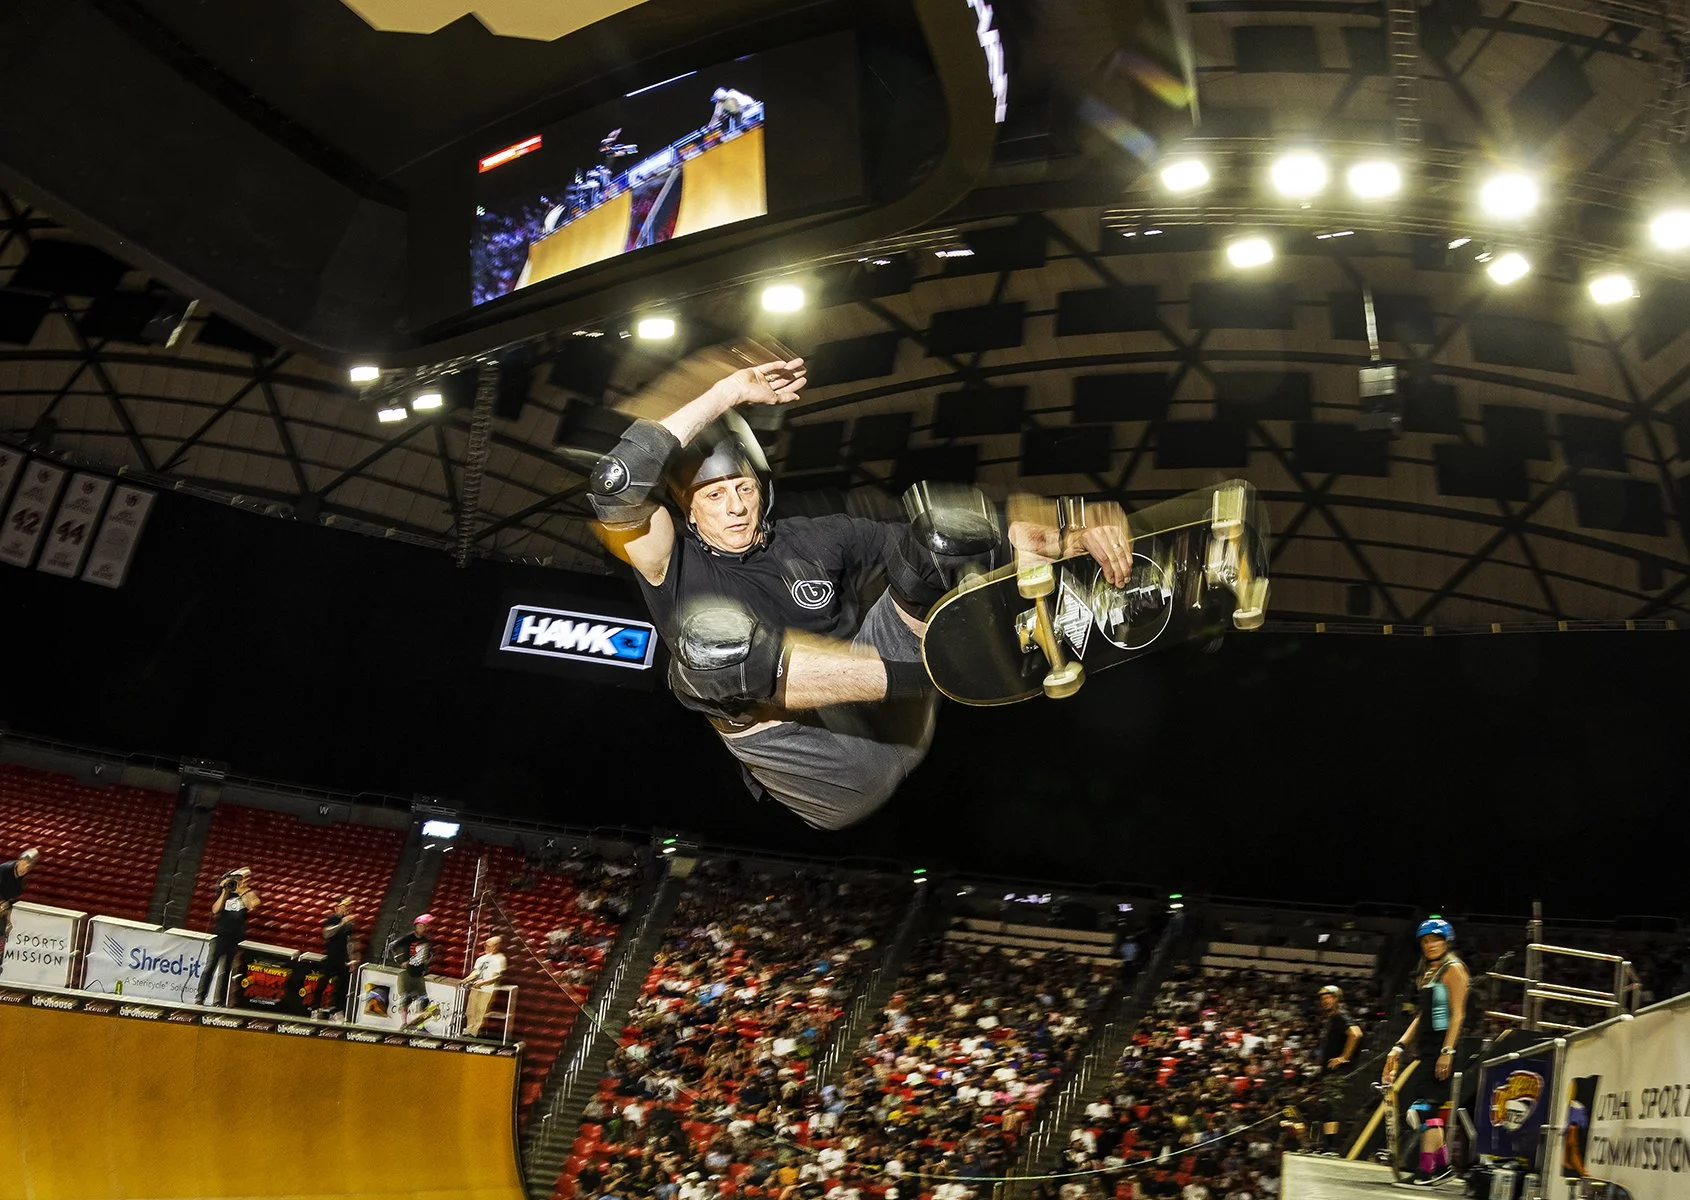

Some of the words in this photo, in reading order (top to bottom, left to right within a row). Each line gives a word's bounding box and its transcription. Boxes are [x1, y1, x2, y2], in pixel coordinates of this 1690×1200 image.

[12, 508, 41, 536] 42
[56, 519, 86, 546] 44
[516, 615, 625, 657] HAWK
[546, 839, 554, 848] X
[16, 934, 64, 950] SPORTS
[4, 950, 62, 966] MISSION
[128, 947, 200, 978] Shred-it
[32, 995, 73, 1010] birdhouse
[119, 1006, 158, 1019] birdhouse
[202, 1016, 238, 1028] birdhouse
[277, 1024, 310, 1036] birdhouse
